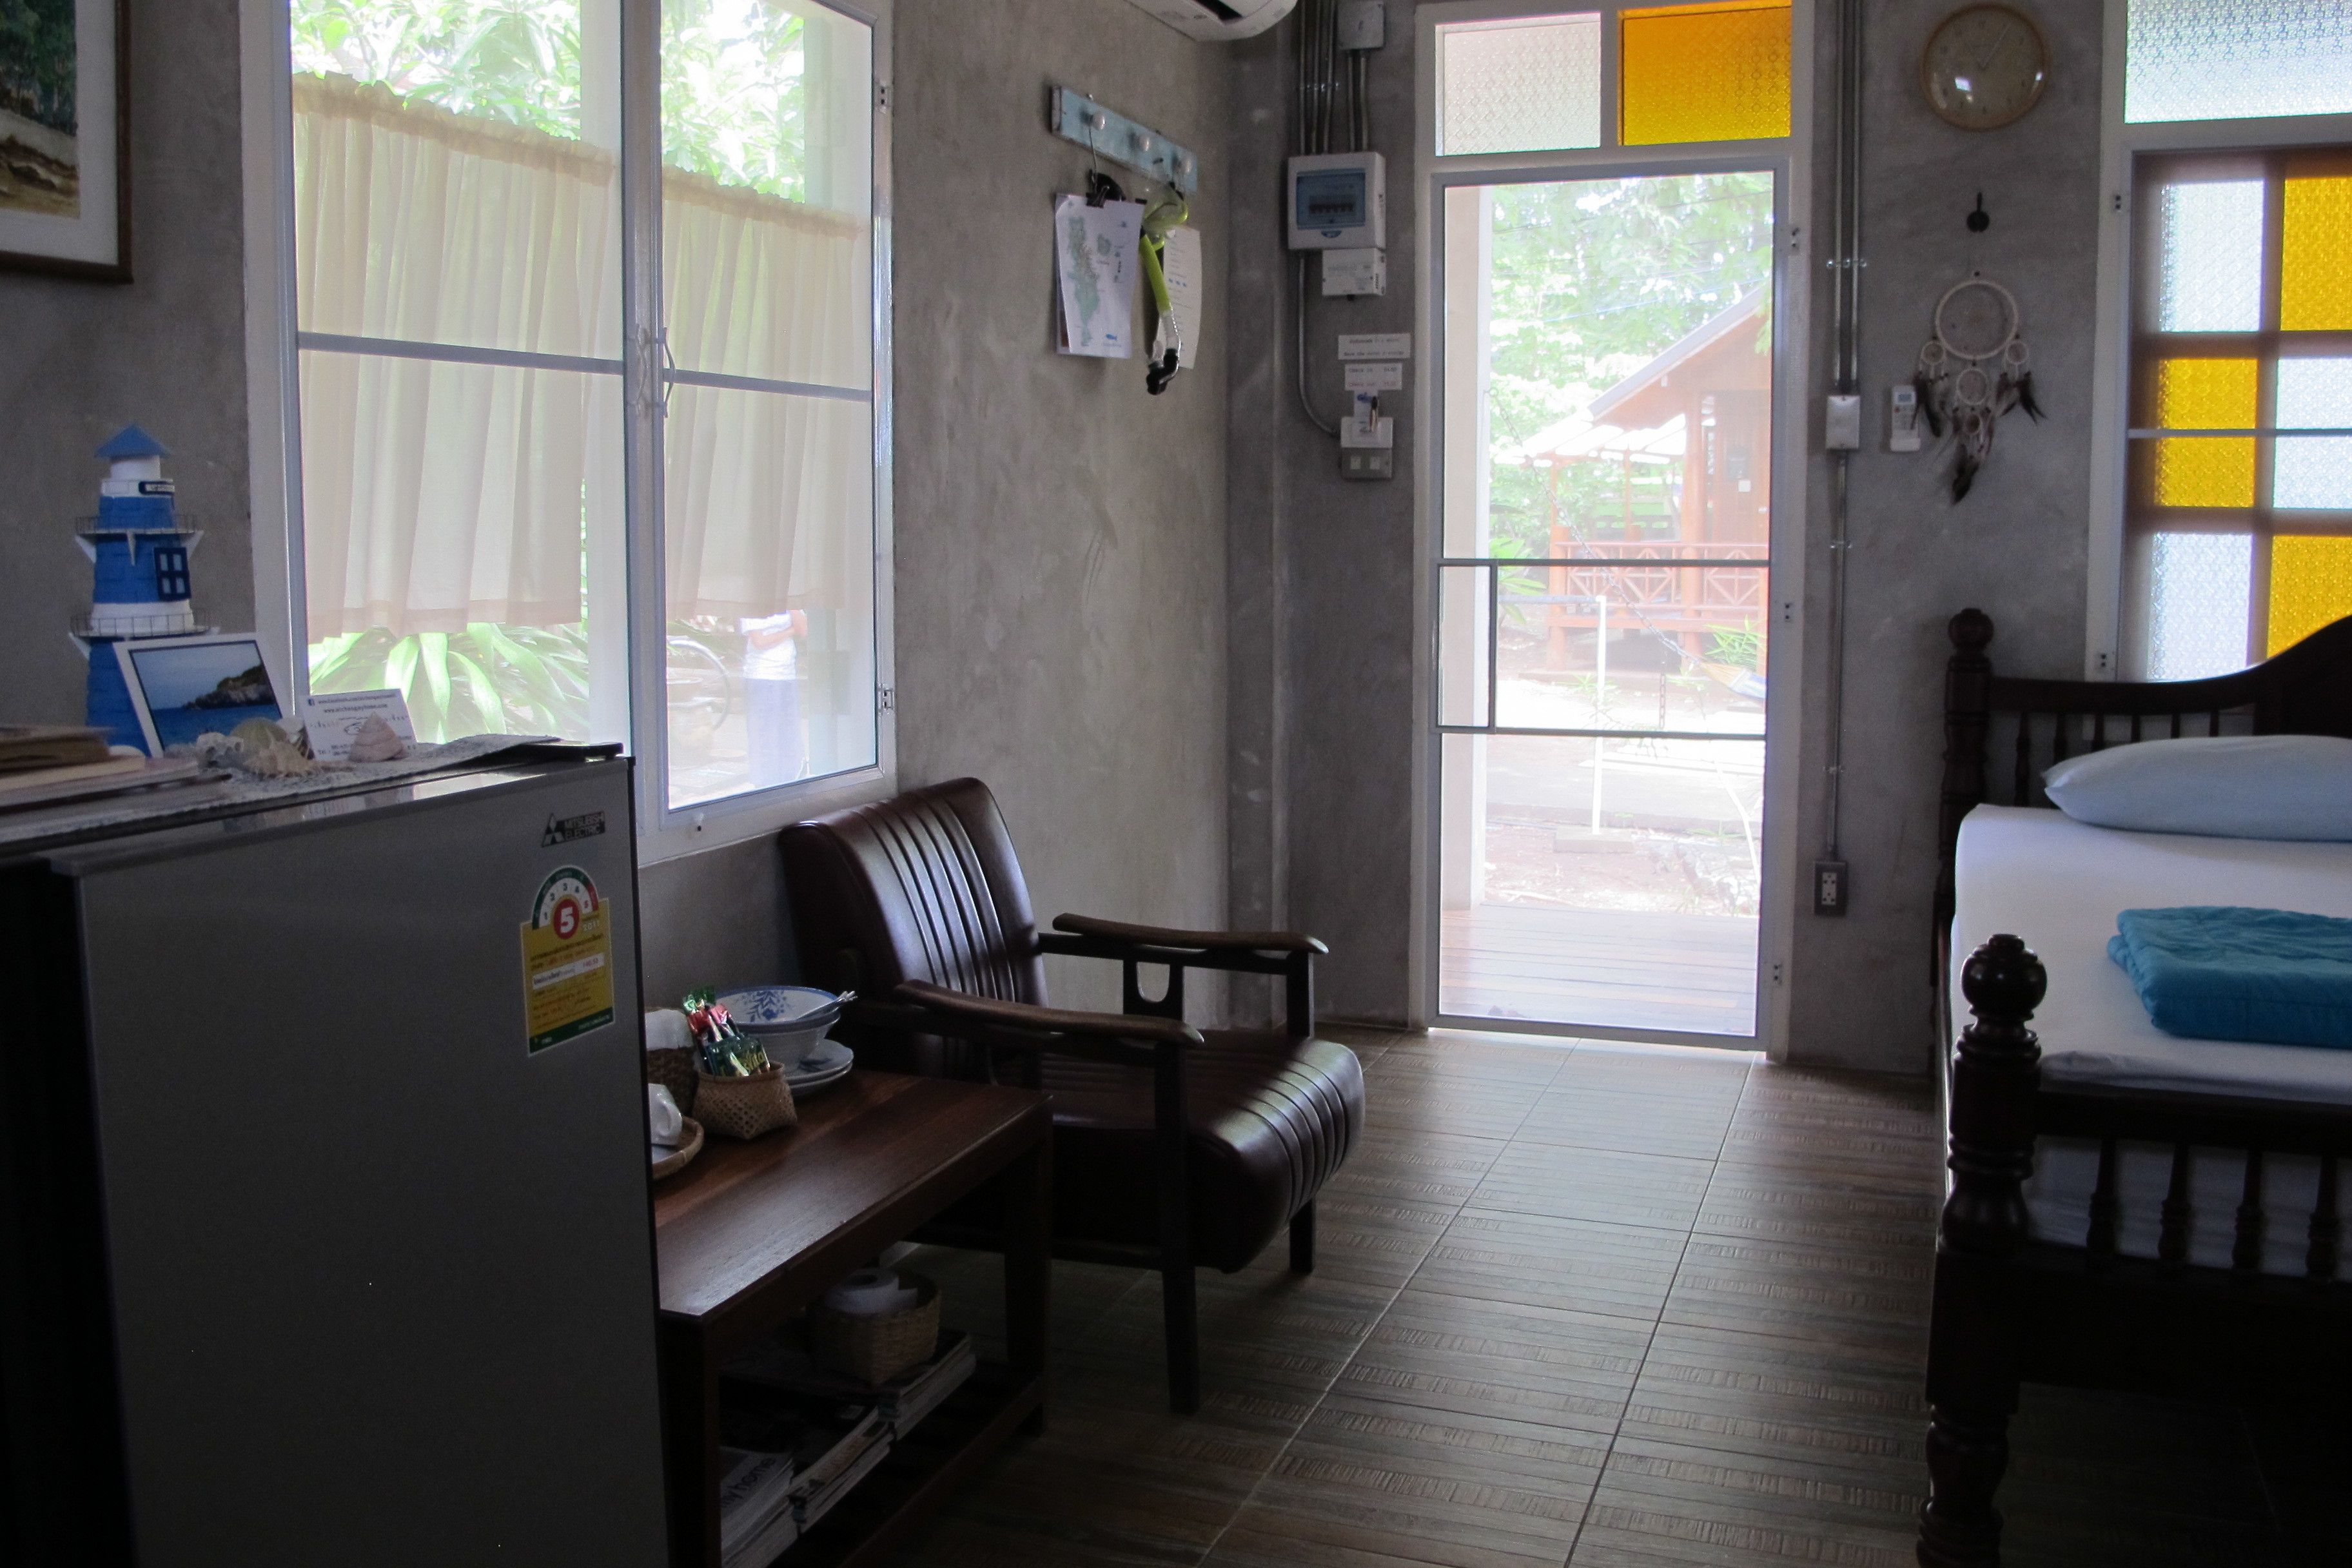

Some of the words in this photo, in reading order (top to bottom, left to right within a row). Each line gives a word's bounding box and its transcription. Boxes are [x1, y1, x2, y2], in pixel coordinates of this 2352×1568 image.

[565, 825, 601, 840] ELECTRIC
[544, 912, 548, 920] 1
[550, 892, 556, 901] 2
[562, 883, 568, 891] 3
[583, 900, 589, 908] 5
[560, 906, 575, 934] 5
